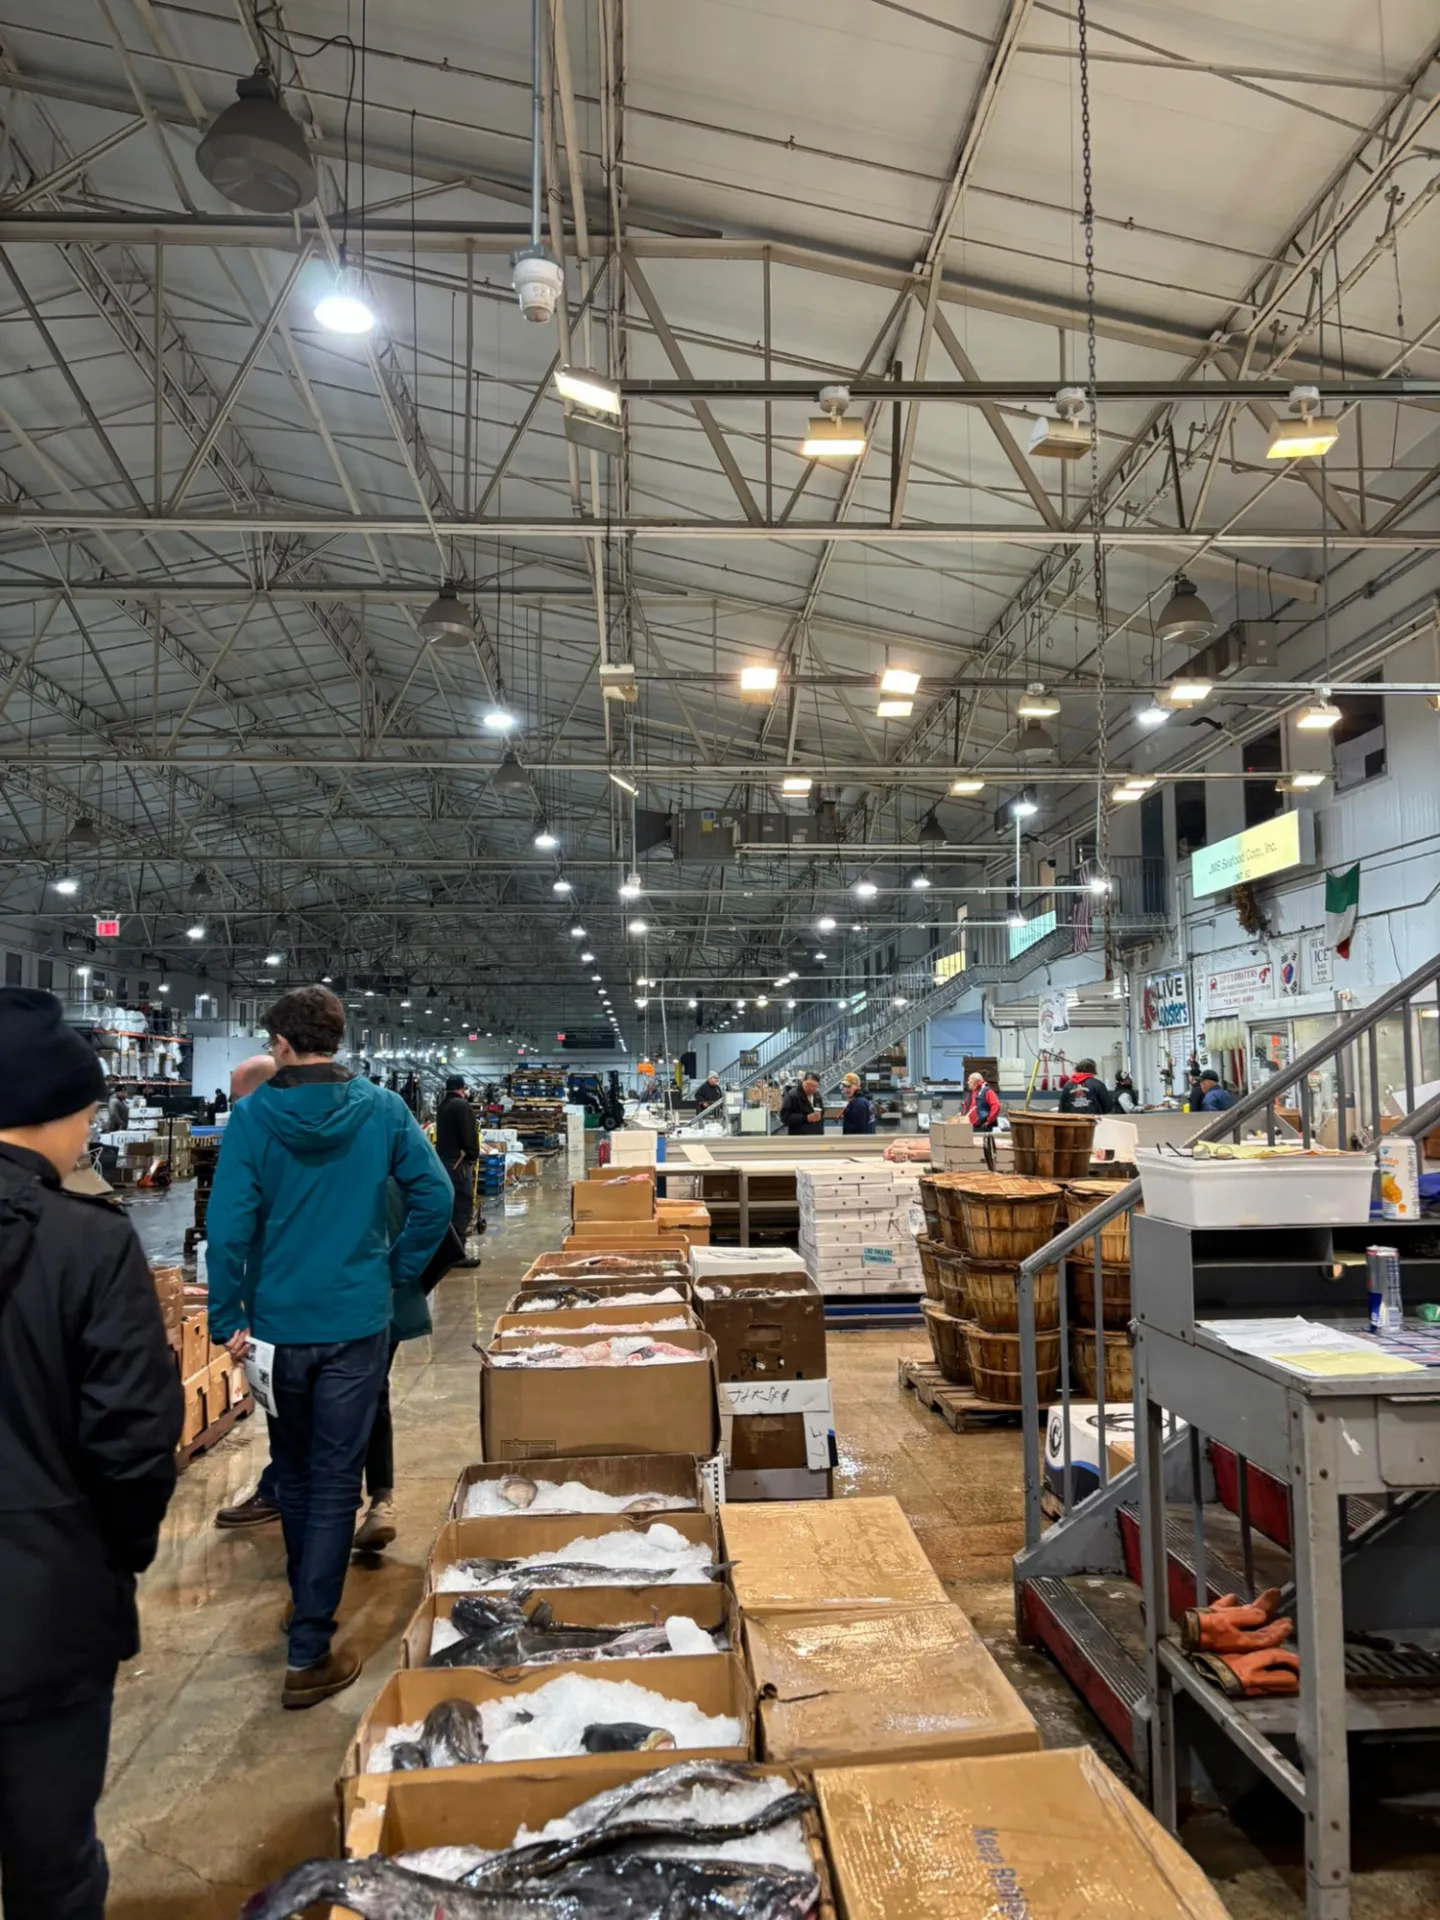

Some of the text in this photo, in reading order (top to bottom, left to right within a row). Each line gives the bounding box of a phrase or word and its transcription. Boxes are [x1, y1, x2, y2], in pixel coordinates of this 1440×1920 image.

[1222, 851, 1245, 870] Seafood
[1314, 949, 1330, 963] ICE
[1156, 976, 1183, 999] LIVE
[1157, 1001, 1188, 1027] Lobsters
